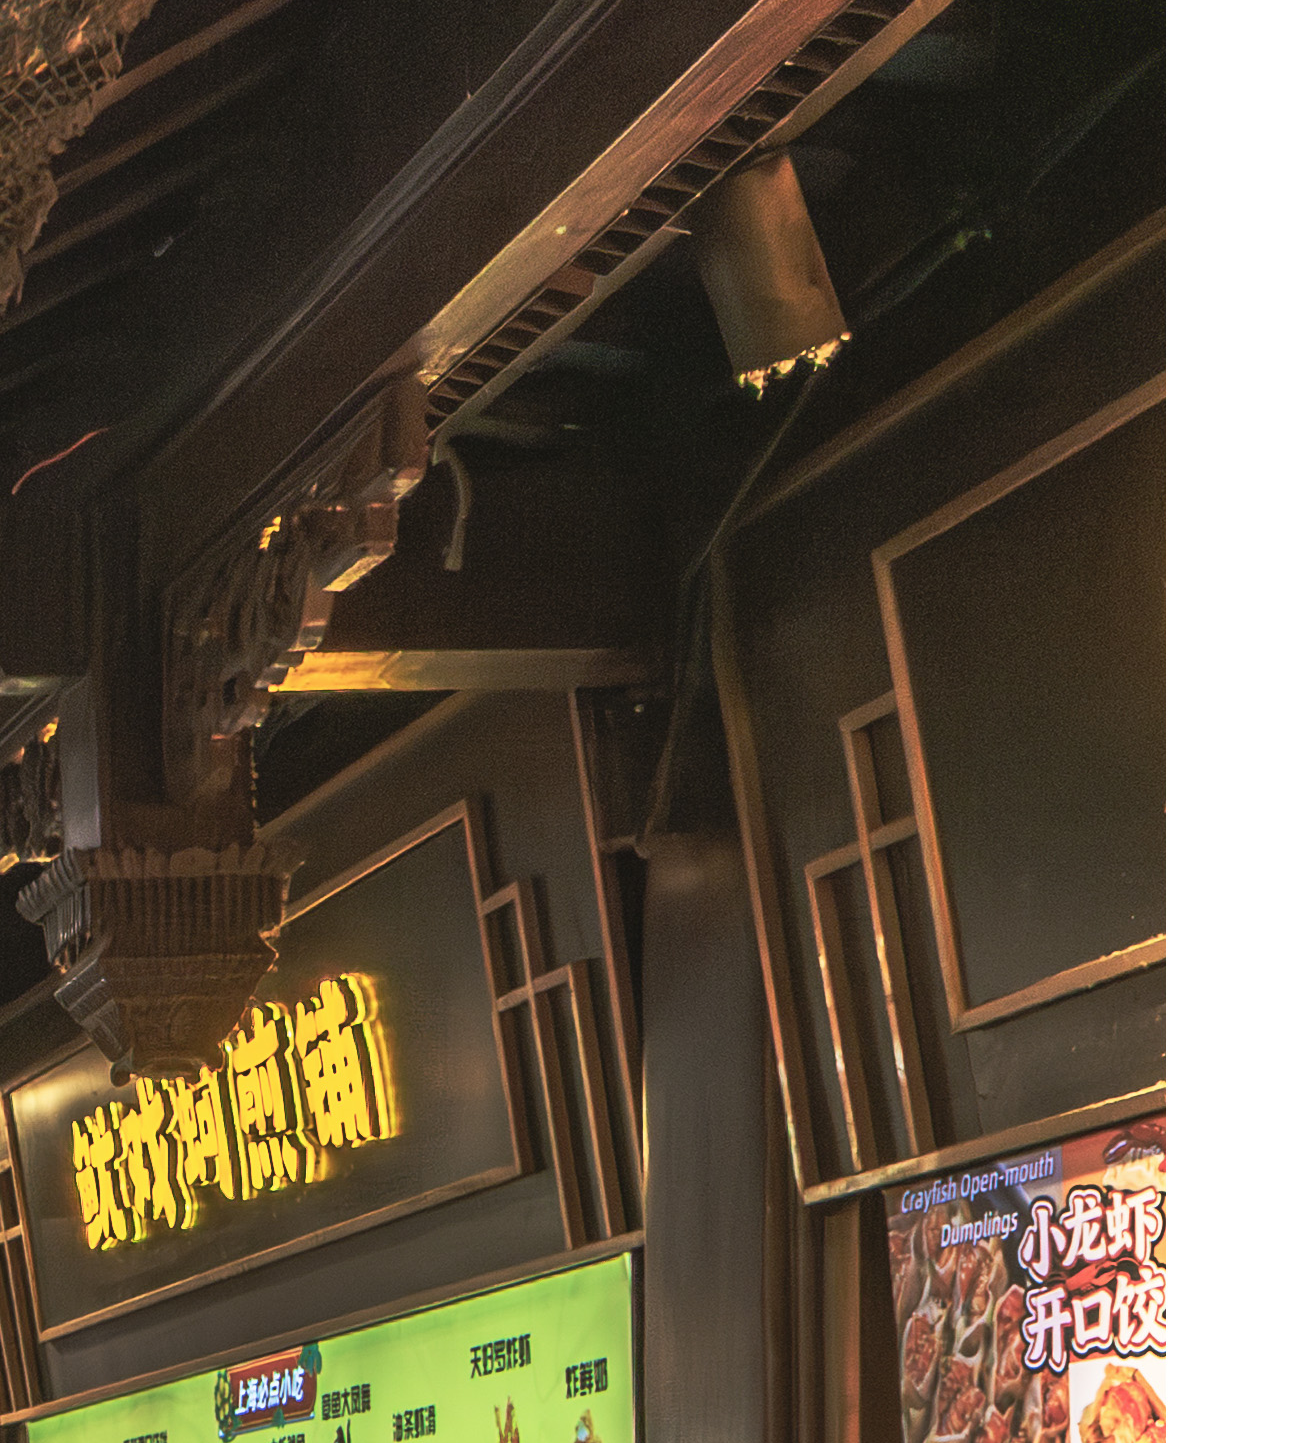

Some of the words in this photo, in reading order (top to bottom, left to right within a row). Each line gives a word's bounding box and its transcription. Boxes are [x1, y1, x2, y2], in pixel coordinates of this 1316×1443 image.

[901, 1173, 957, 1214] Crayfish
[960, 1153, 1054, 1198] Open-mouth
[940, 1211, 1019, 1249] Dumplings
[1022, 1187, 1161, 1274] 小龙虾
[1025, 1265, 1165, 1367] 开口饺
[234, 1368, 305, 1414] 上海必点小吃
[565, 1357, 608, 1399] 炸鲜奶
[392, 1405, 436, 1442] 油条虾滑
